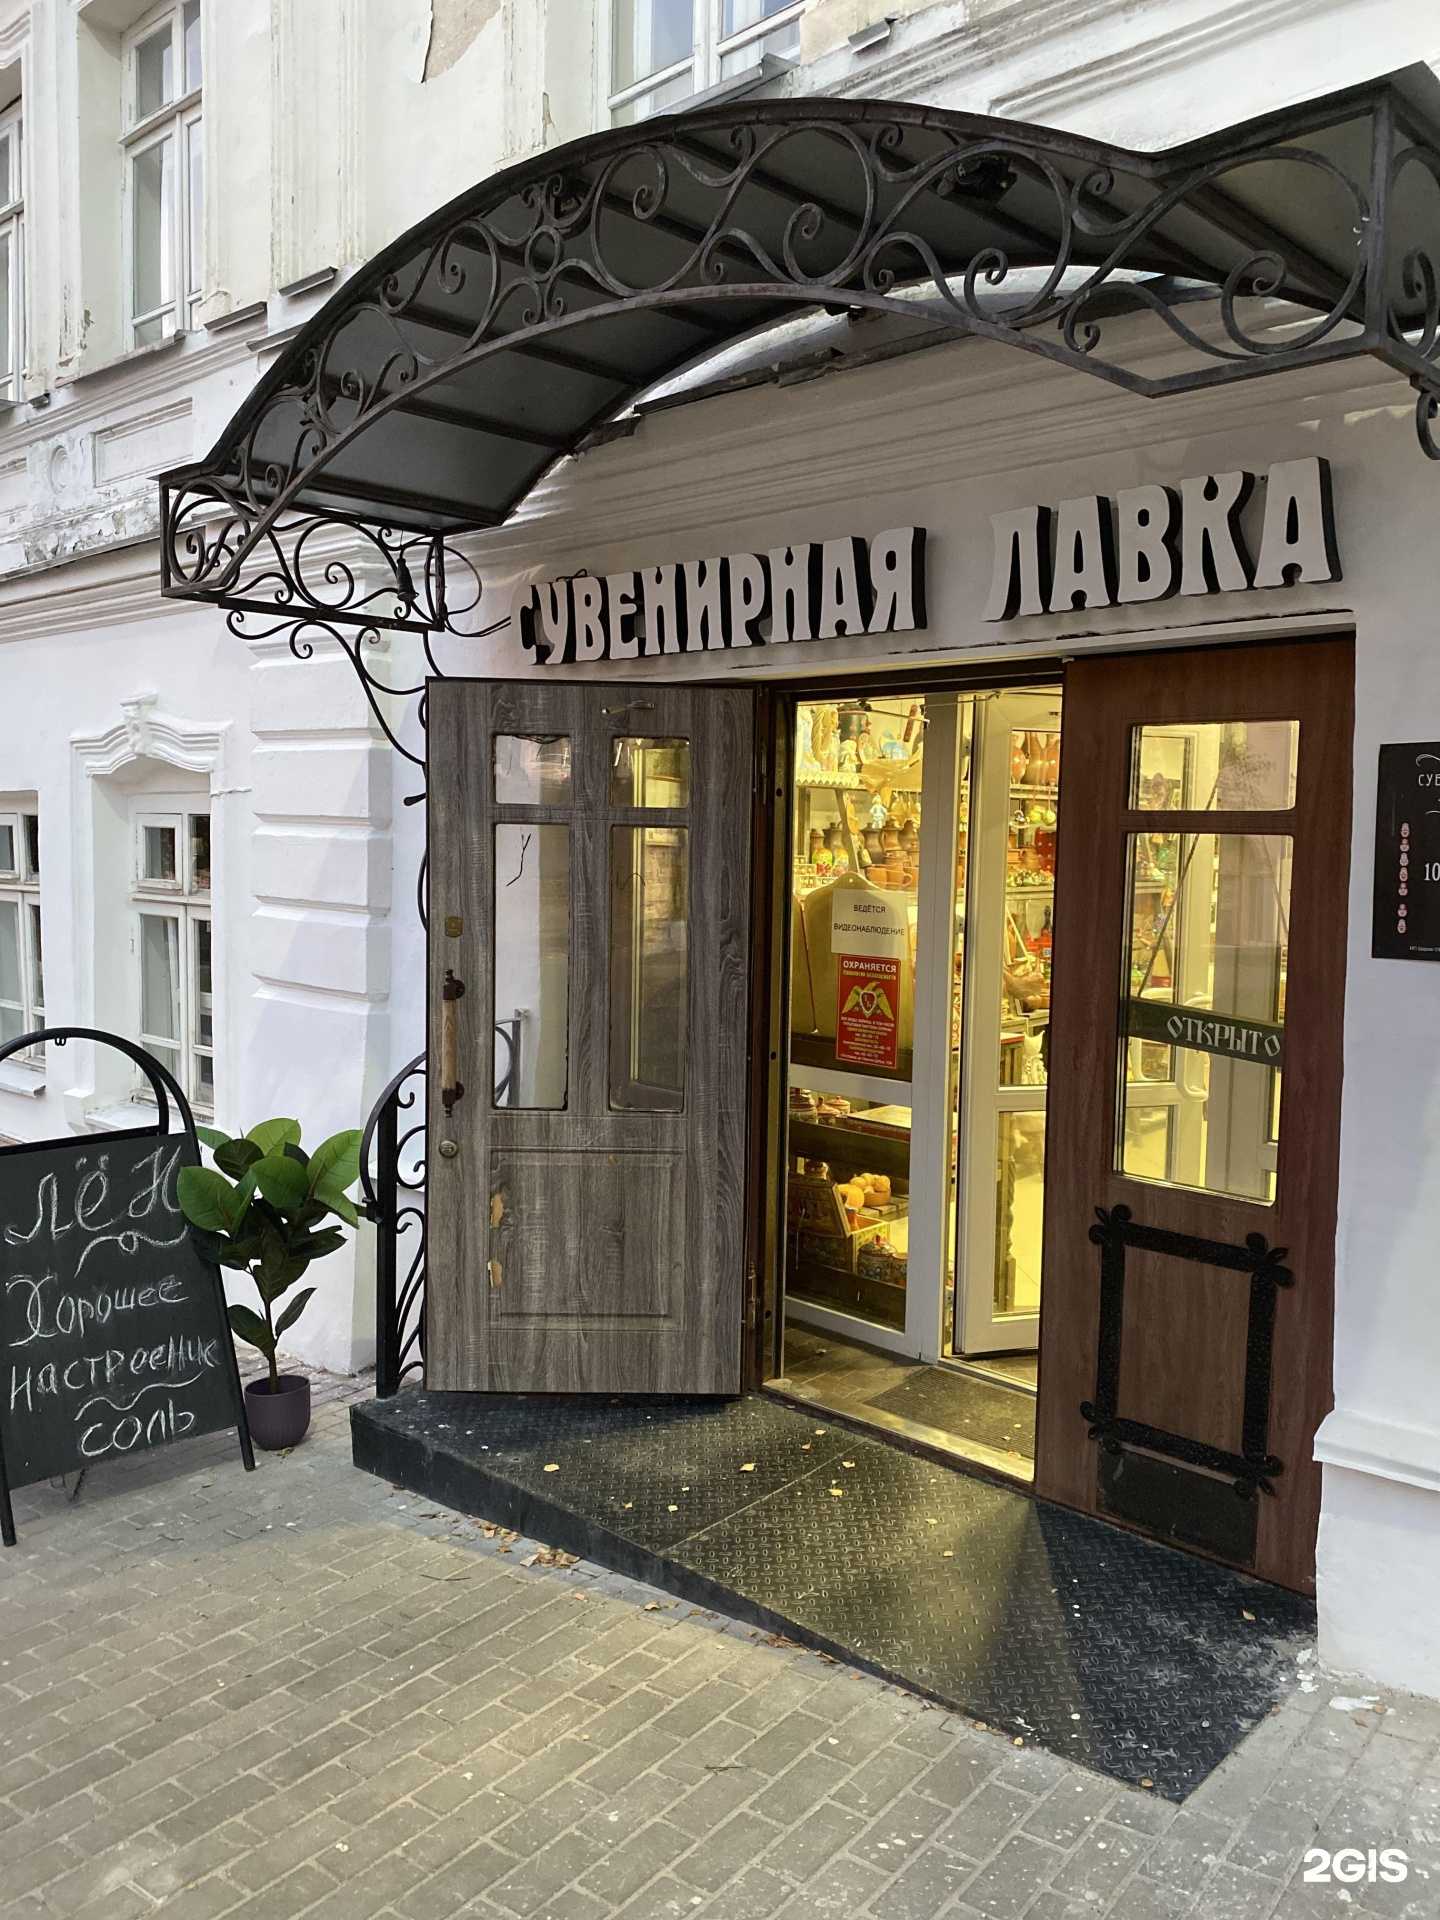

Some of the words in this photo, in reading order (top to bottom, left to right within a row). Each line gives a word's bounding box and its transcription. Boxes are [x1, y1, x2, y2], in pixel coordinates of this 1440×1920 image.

[510, 526, 927, 666] СУВЕНИРНАЯ
[985, 456, 1342, 622] ЛАВКА
[833, 922, 905, 936] ВИДЕОНАБЛЮДЕНИЕ
[843, 960, 897, 973] ОХРАНЯЕТСЯ
[1166, 1015, 1281, 1057] ОТКРЫТО
[5, 1273, 190, 1347] Хорошее
